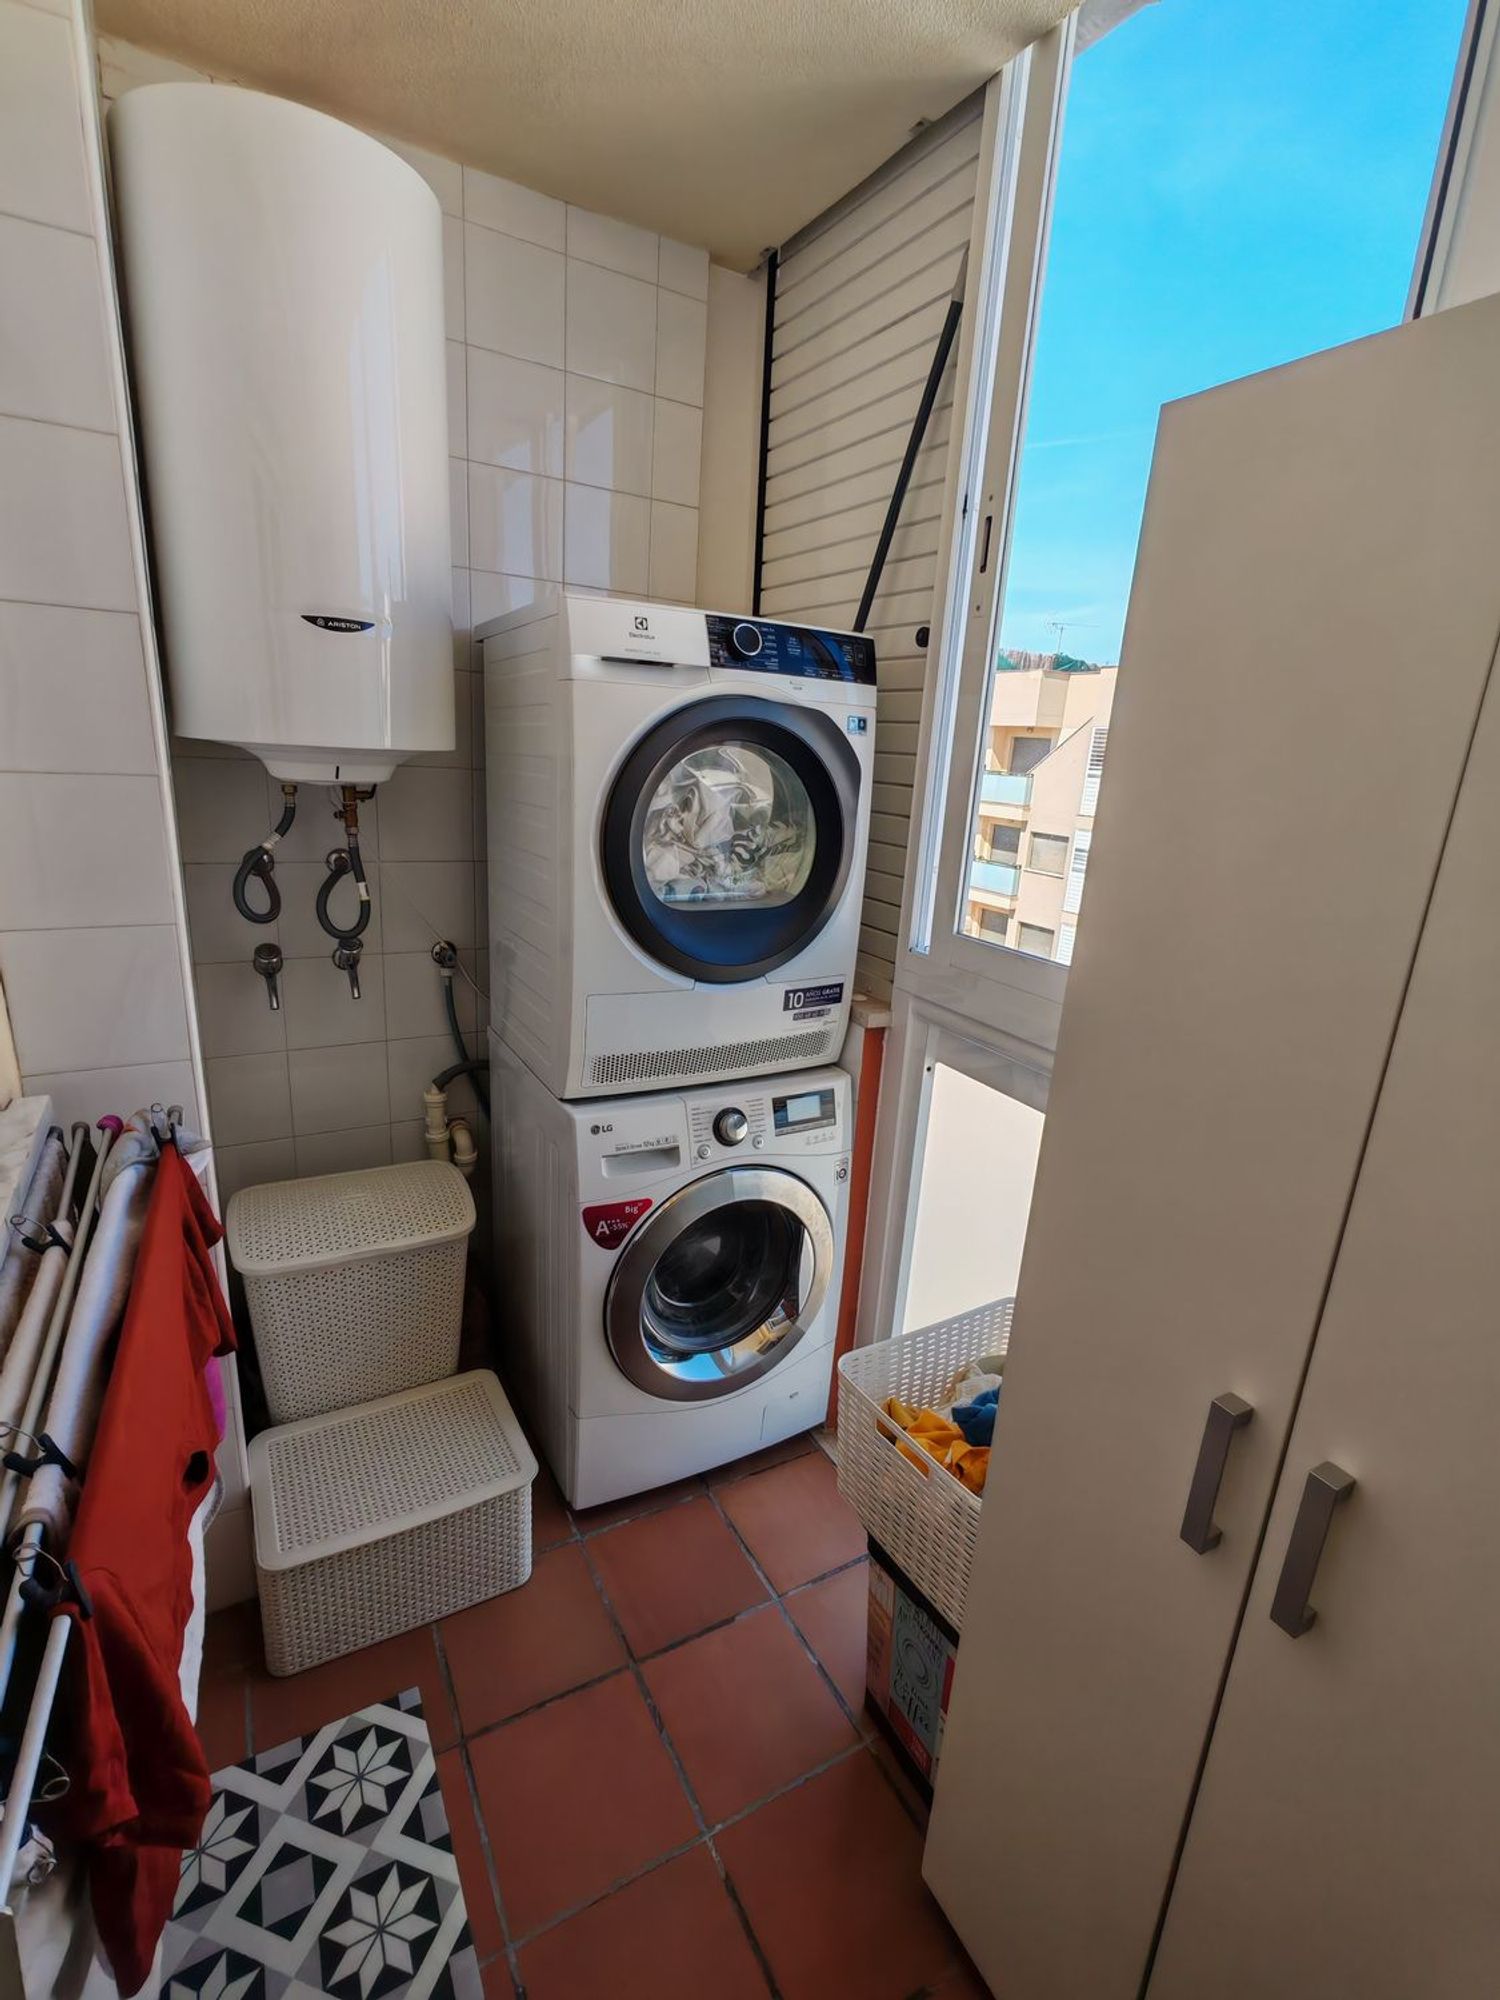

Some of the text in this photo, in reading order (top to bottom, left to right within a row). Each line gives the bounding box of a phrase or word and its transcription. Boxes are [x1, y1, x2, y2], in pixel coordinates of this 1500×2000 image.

[327, 621, 361, 629] ARISTON
[788, 992, 804, 1009] 10
[602, 1124, 613, 1133] LG
